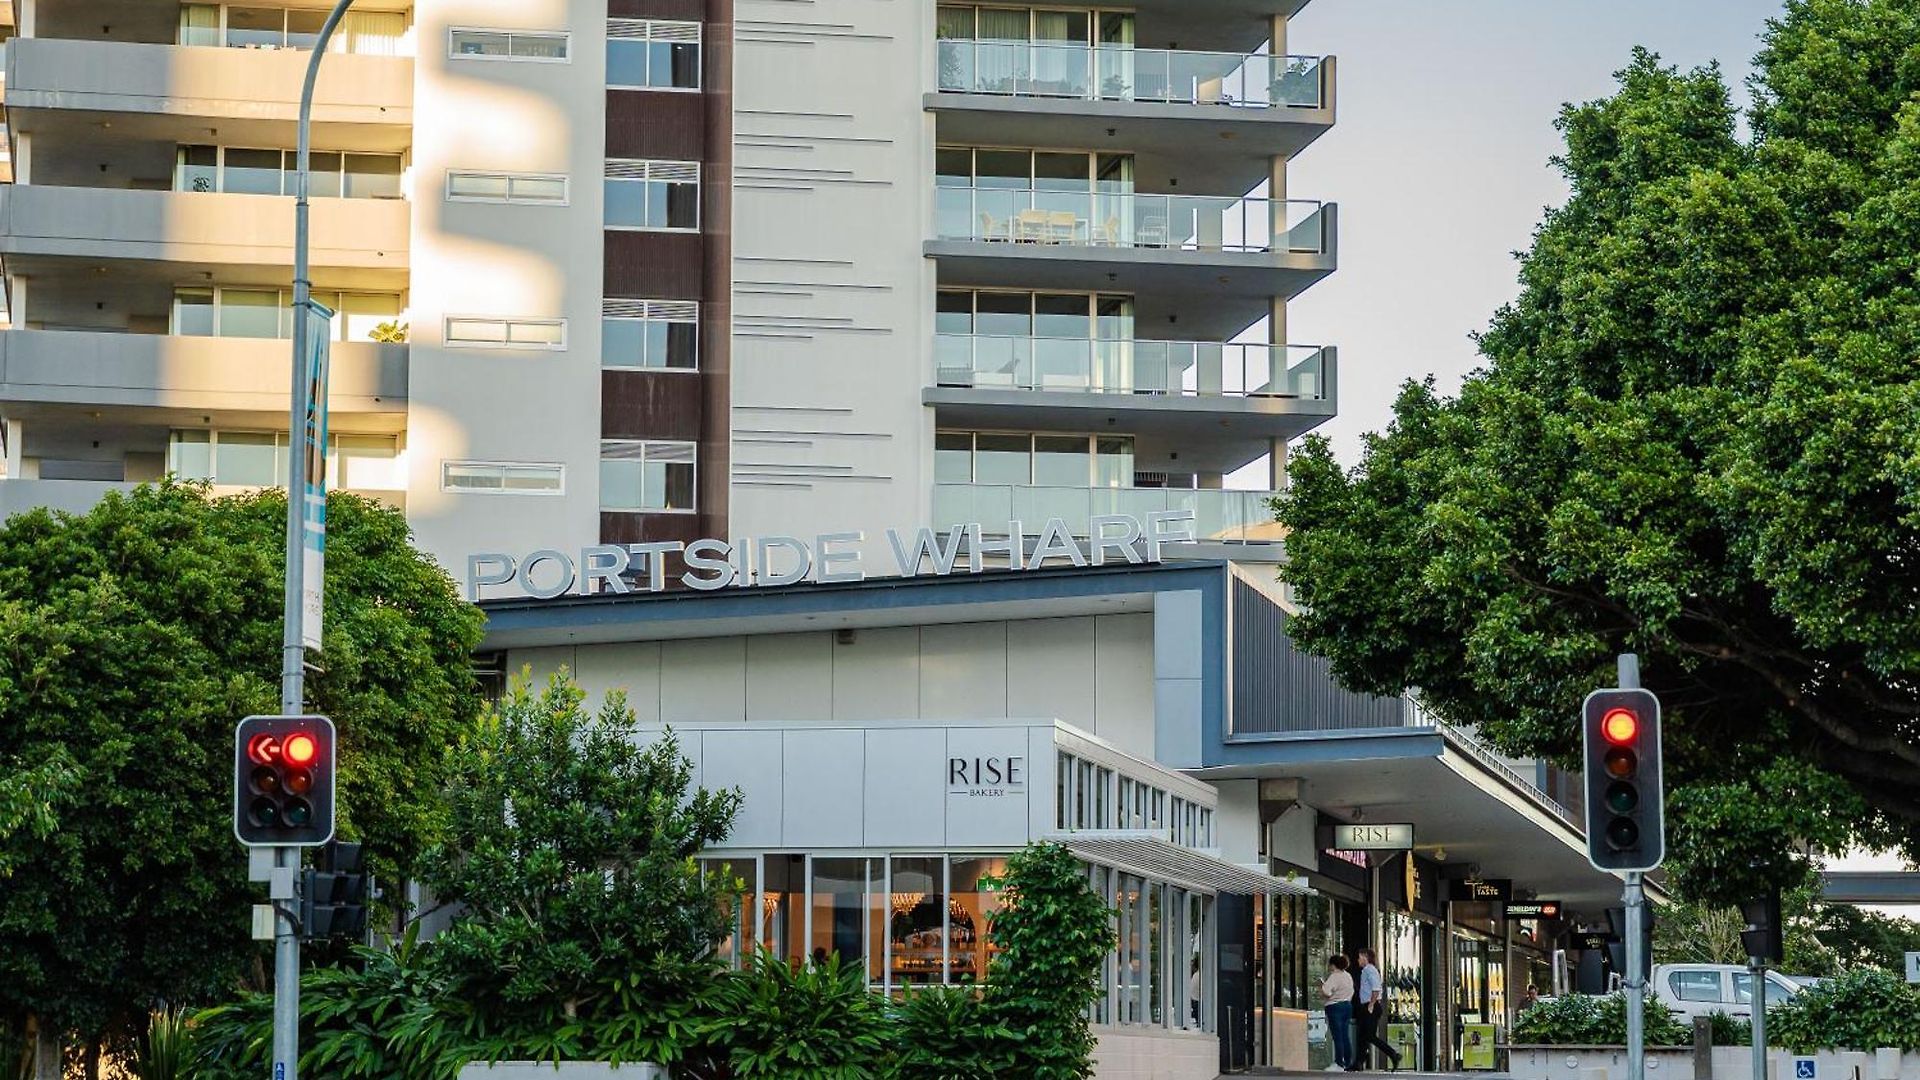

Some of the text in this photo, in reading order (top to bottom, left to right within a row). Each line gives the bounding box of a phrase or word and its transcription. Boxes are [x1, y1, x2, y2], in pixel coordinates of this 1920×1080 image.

[467, 509, 1196, 602] PORTSIDE WHARF
[949, 757, 1023, 785] RISE
[969, 788, 1004, 797] BAKERY
[1353, 826, 1391, 842] RISE
